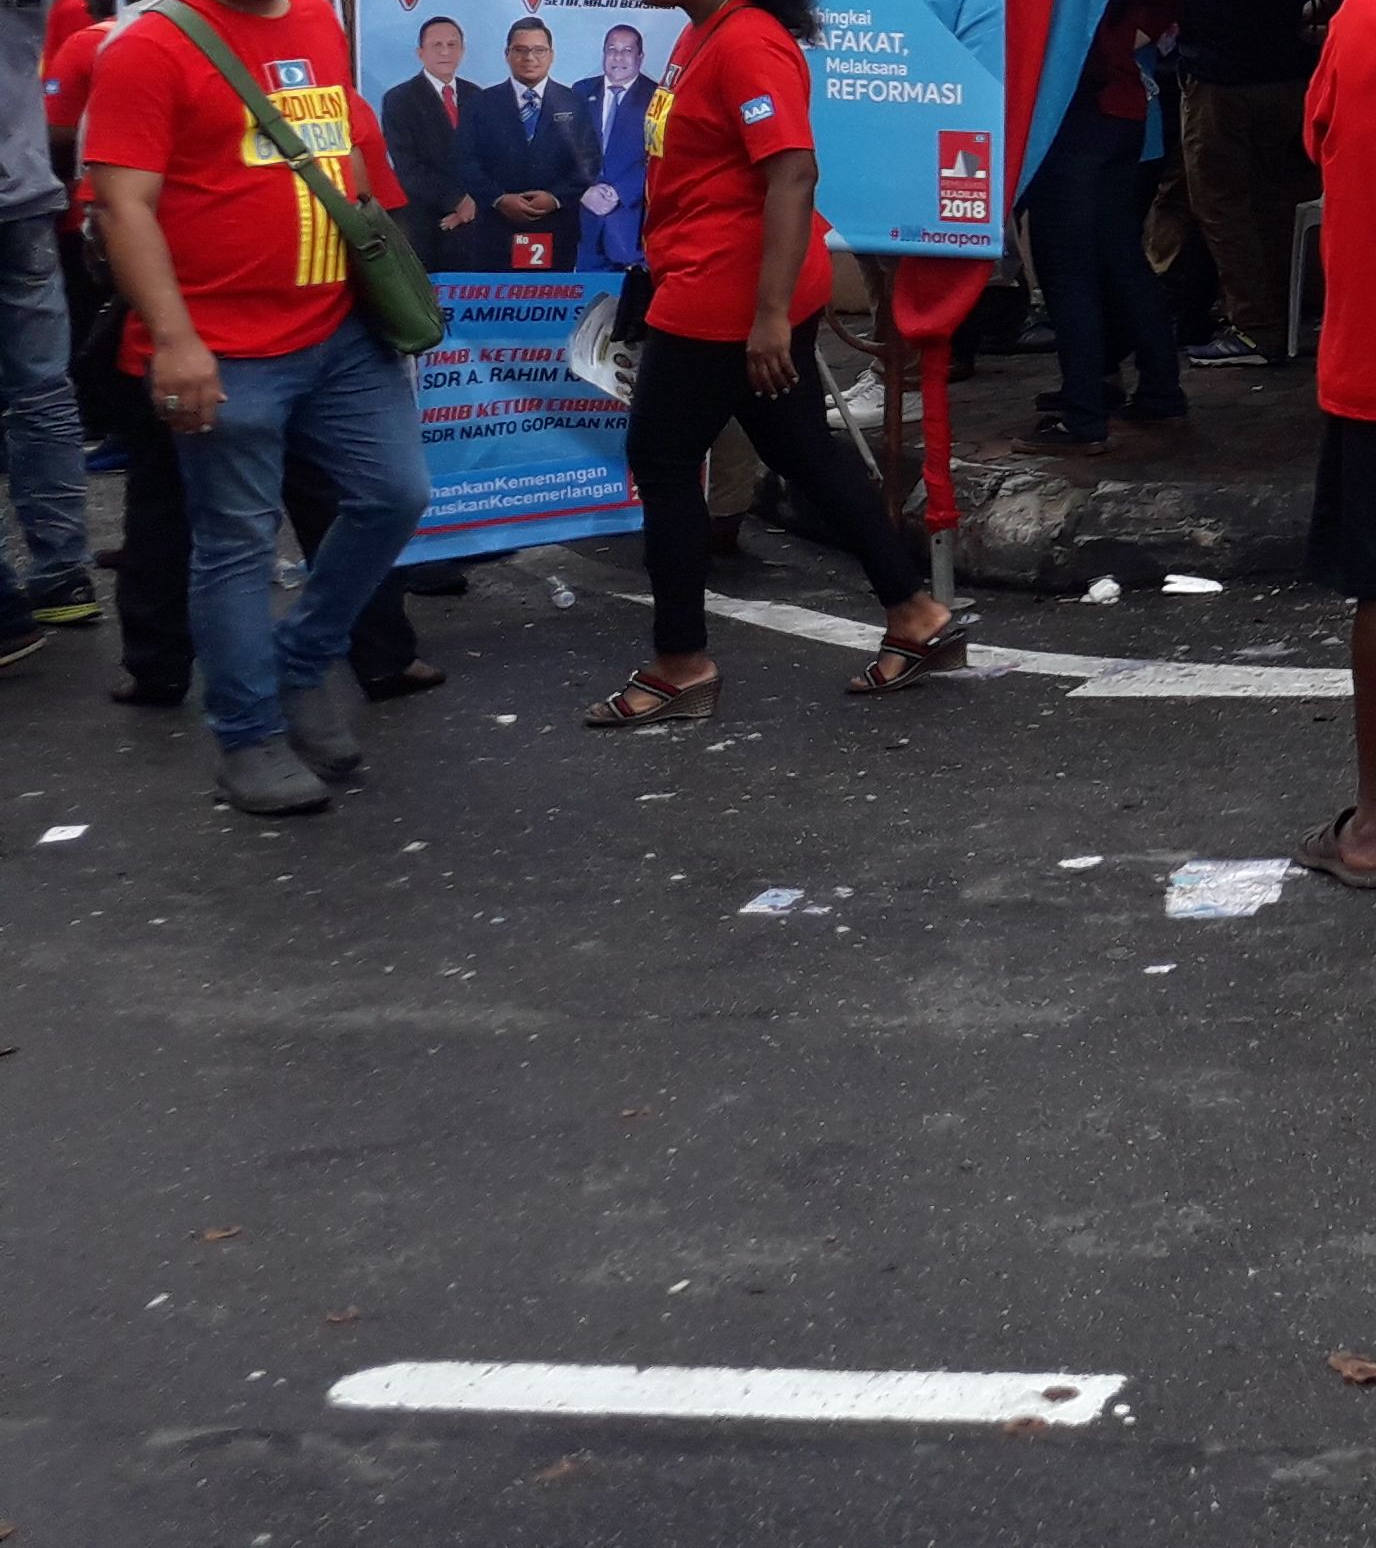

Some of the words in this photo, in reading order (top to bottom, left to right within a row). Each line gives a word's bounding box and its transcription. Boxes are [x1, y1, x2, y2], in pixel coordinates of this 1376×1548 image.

[815, 7, 872, 27] bingkai
[801, 30, 909, 56] AFAKAT,
[826, 57, 908, 76] Melaksana
[827, 79, 963, 105] REFORMASI
[744, 103, 771, 120] AAA
[941, 199, 986, 219] 2018
[529, 243, 545, 265] 2
[432, 284, 491, 301] ETUA
[460, 306, 565, 322] AMIRUDIN
[479, 348, 553, 363] KETUA
[423, 369, 460, 390] SDR
[466, 369, 483, 384] A.
[490, 367, 558, 383] RAHIM
[421, 406, 473, 424] NAIB
[477, 399, 544, 418] KETUA
[421, 428, 455, 444] SDR
[459, 421, 517, 440] NANTO
[522, 417, 600, 433] GOPALAN
[430, 466, 607, 499] hankanKemenangan
[423, 480, 623, 517] ruskanKecemerlangan
